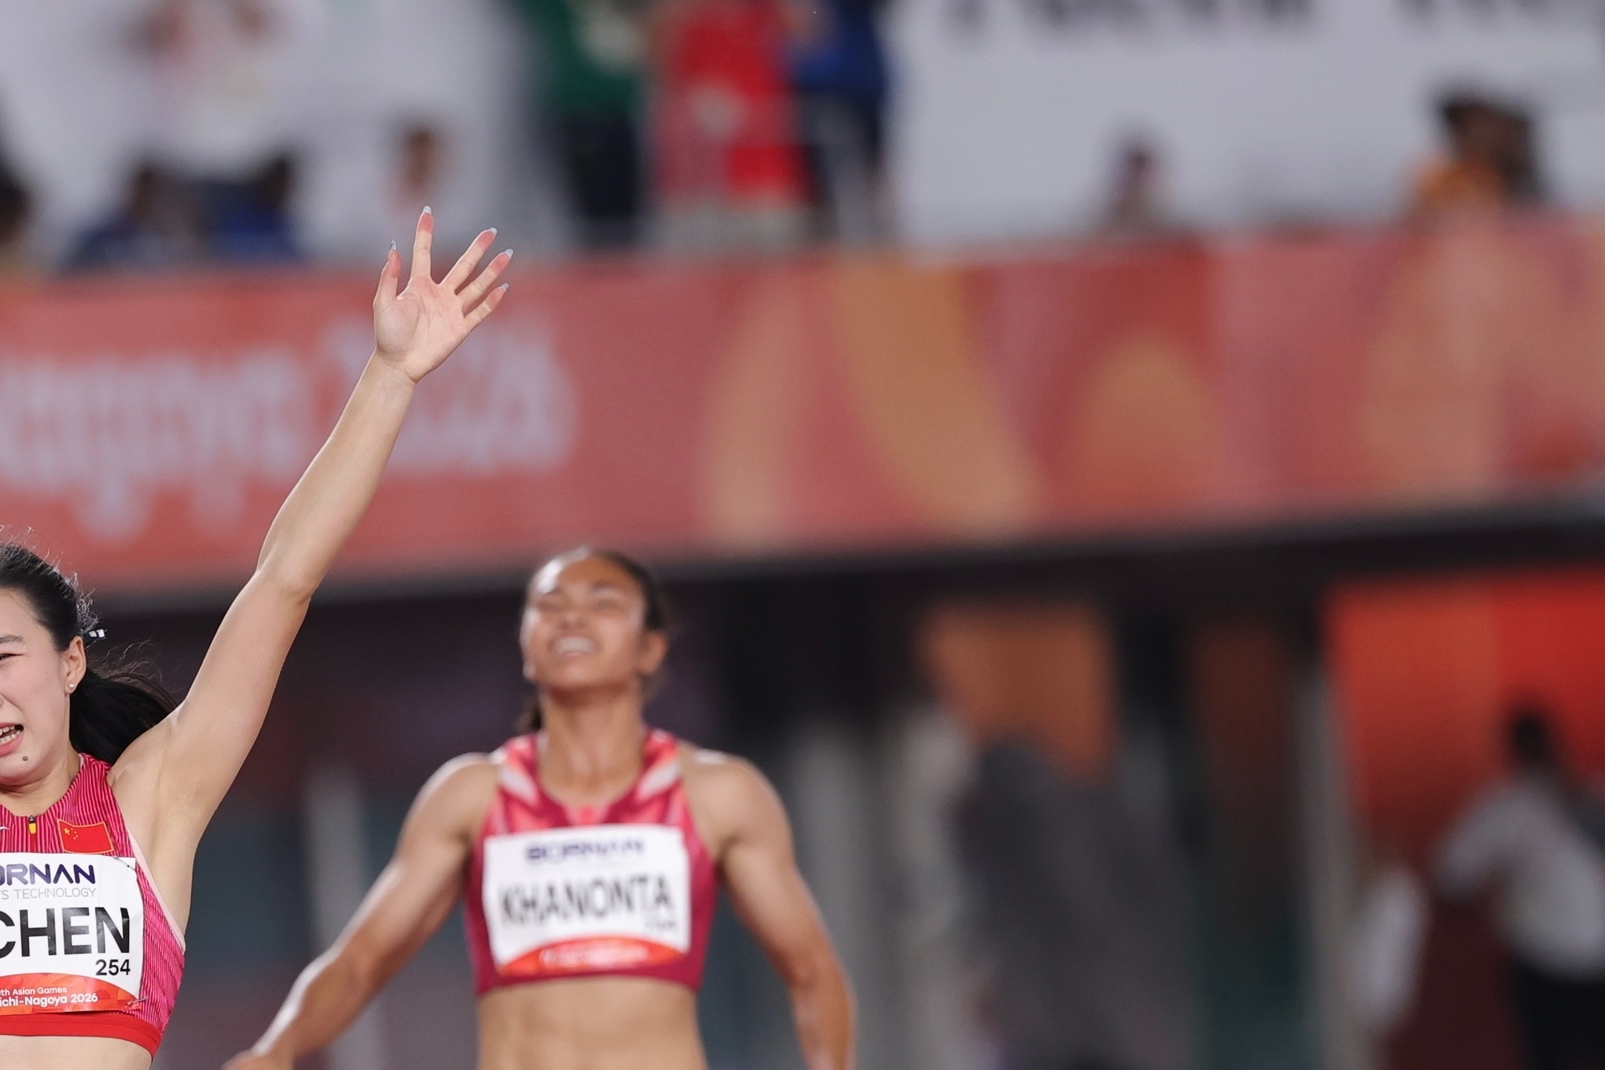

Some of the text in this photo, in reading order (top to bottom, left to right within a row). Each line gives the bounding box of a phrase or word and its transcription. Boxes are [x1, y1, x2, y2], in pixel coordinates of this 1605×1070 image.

[13, 887, 97, 899] TECHNOLOGY
[500, 873, 672, 927] KHANONTA
[95, 959, 131, 976] 254
[12, 987, 36, 996] Asian
[37, 986, 68, 995] Games
[70, 993, 98, 1003] 2026
